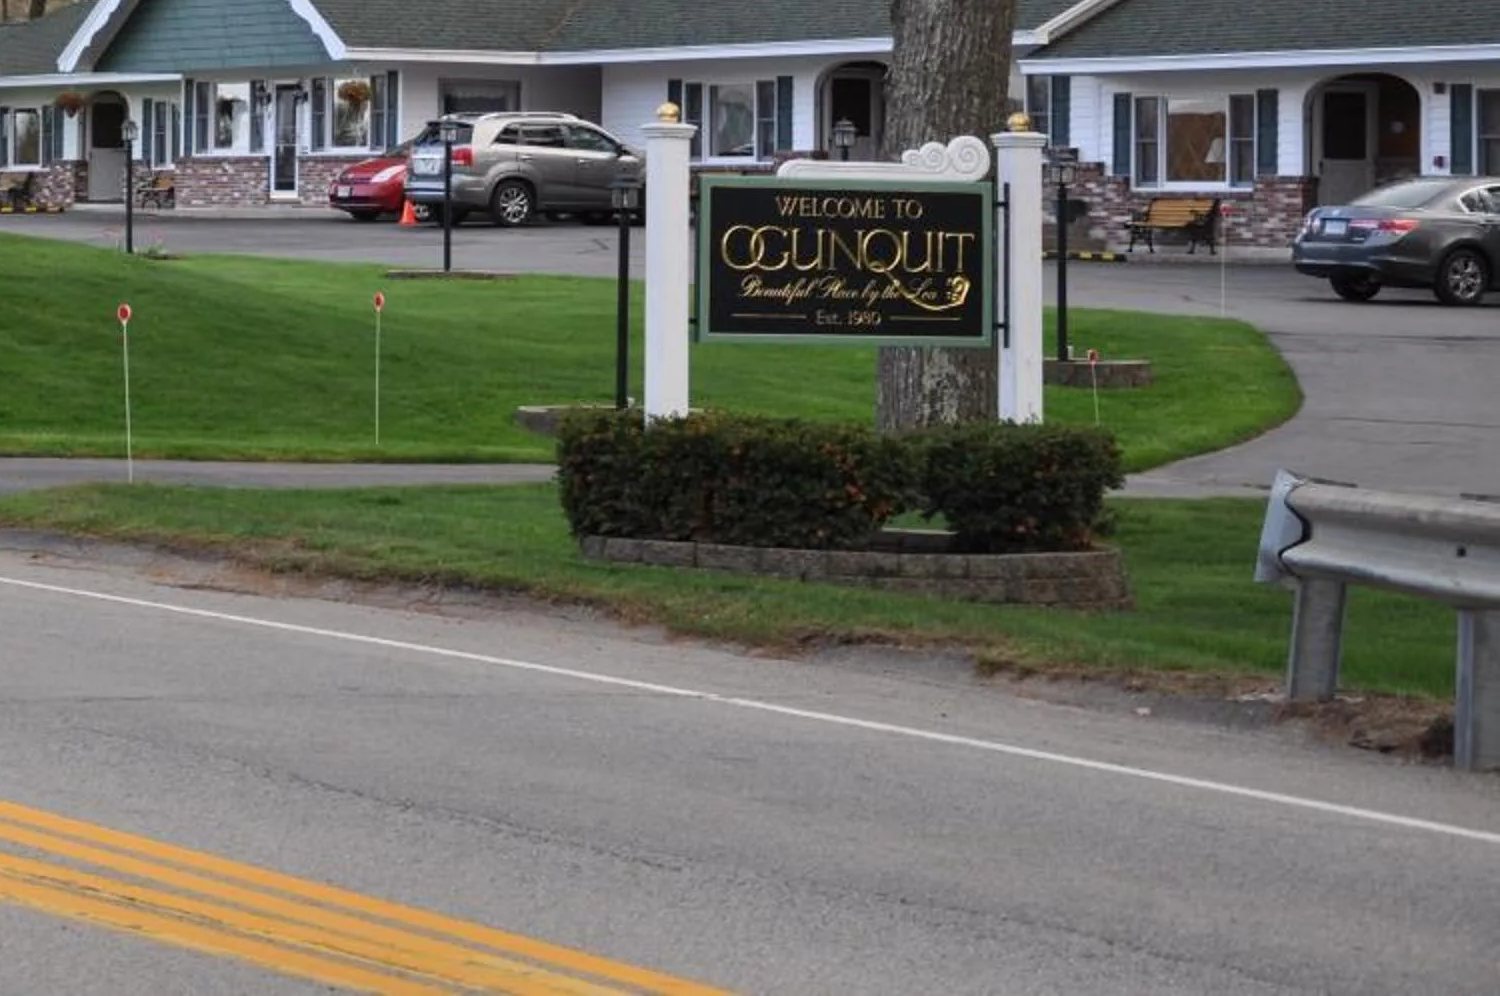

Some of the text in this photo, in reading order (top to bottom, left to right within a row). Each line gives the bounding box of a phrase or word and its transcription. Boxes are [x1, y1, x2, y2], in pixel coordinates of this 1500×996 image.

[776, 196, 923, 218] WELCOME TO
[721, 225, 975, 273] OGUNQUIT
[739, 273, 820, 306] Beautiful
[816, 275, 859, 299] Place
